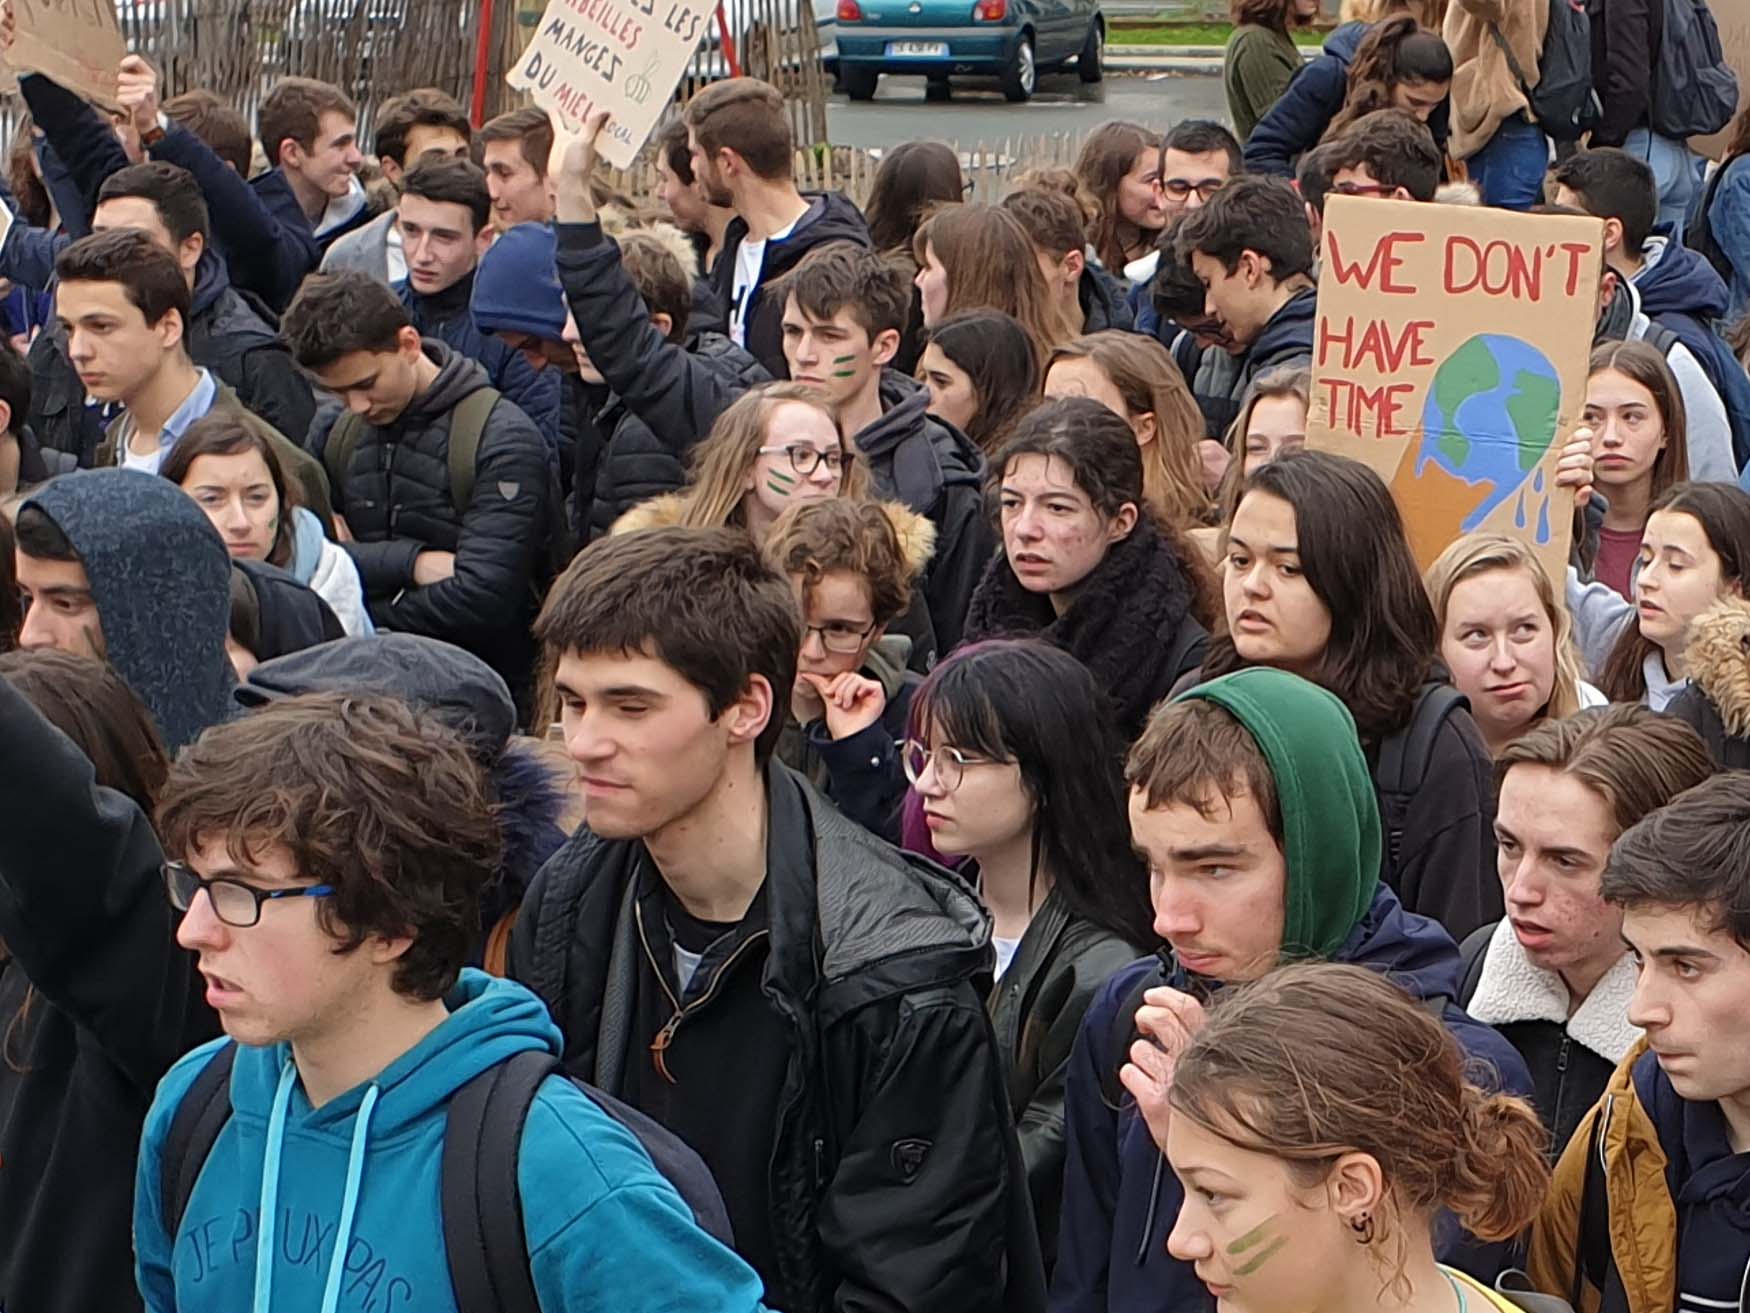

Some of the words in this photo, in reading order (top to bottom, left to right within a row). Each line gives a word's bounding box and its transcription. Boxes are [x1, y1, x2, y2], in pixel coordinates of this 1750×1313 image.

[544, 17, 623, 83] MANGES
[665, 3, 700, 42] LES
[525, 51, 557, 90] DU
[553, 81, 594, 124] MIEL
[1327, 230, 1425, 294] WE
[1444, 235, 1592, 301] DON'T
[1319, 315, 1435, 373] HAVE
[1318, 378, 1415, 439] TIME
[186, 1216, 222, 1283] JE
[231, 1207, 334, 1274] PUX
